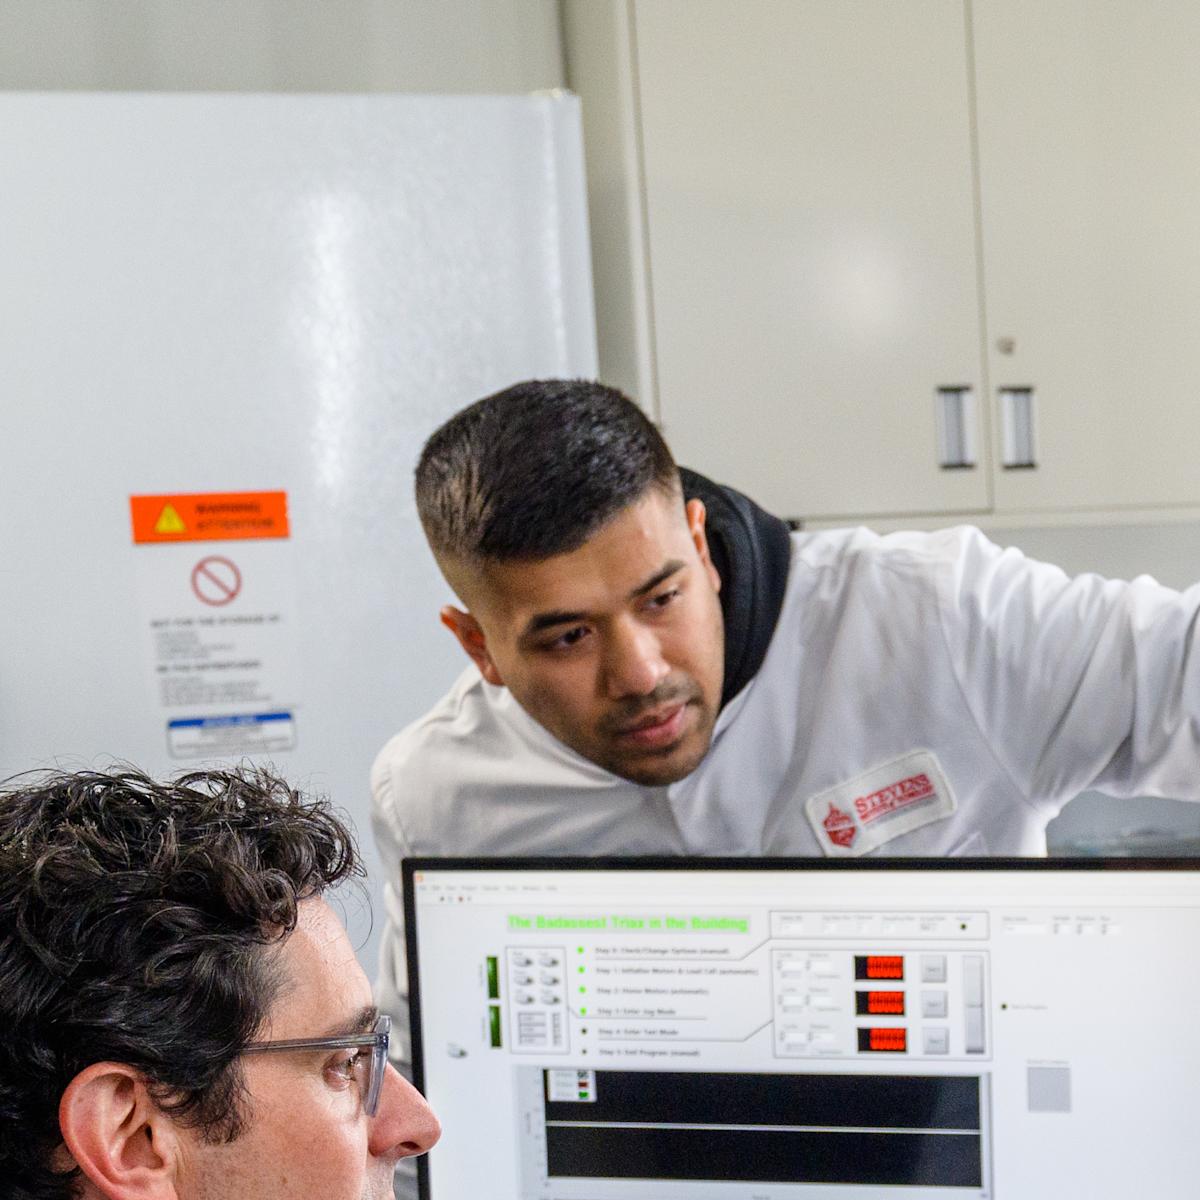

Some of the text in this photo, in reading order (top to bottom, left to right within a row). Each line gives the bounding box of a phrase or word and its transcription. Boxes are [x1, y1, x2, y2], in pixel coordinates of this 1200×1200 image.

[507, 914, 531, 929] The
[648, 914, 662, 930] in
[665, 914, 687, 930] the
[691, 915, 748, 934] Building
